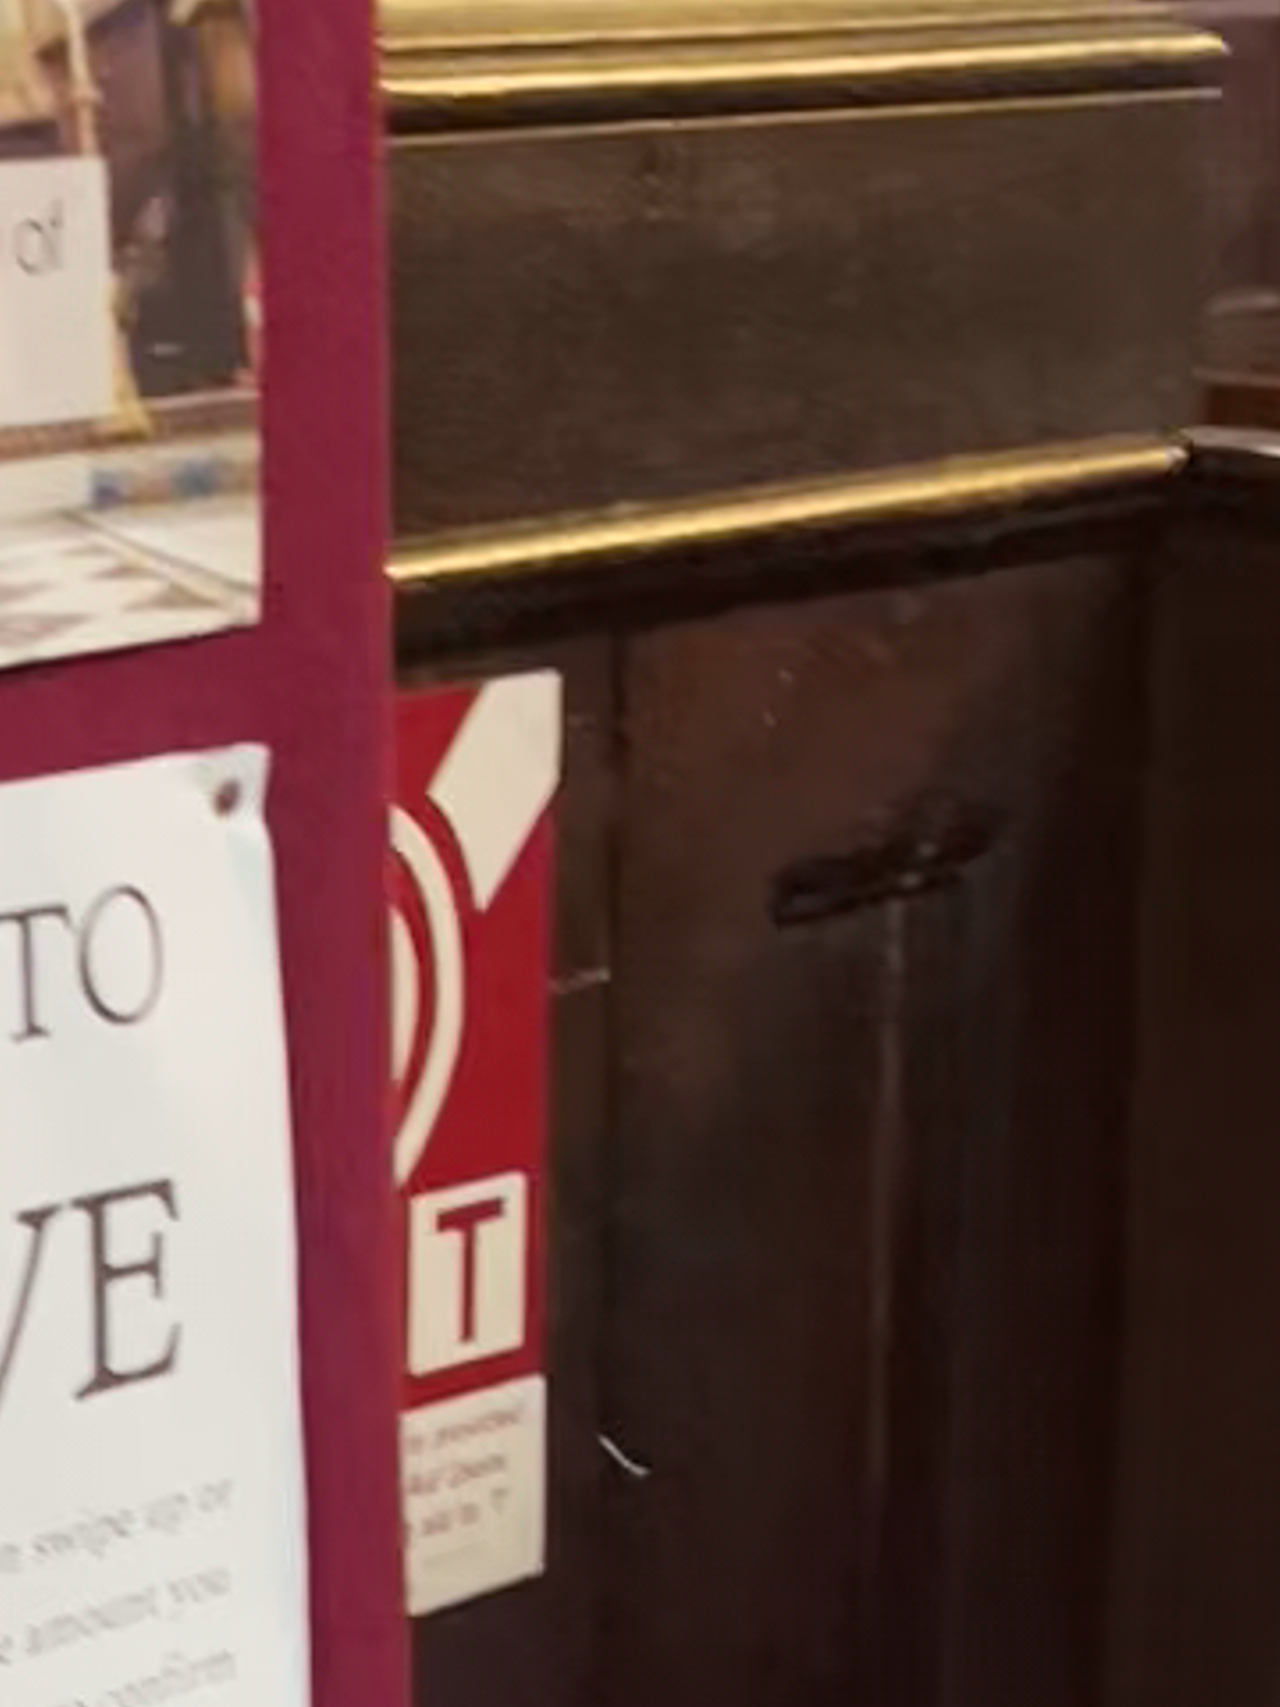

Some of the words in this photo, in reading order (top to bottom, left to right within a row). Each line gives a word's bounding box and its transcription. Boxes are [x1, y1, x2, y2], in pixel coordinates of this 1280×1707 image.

[15, 208, 66, 276] of
[435, 1196, 505, 1344] T
[31, 1507, 136, 1559] swipe
[144, 1491, 190, 1535] up
[196, 1477, 233, 1512] or
[23, 1585, 160, 1657] amount
[166, 1566, 232, 1617] you
